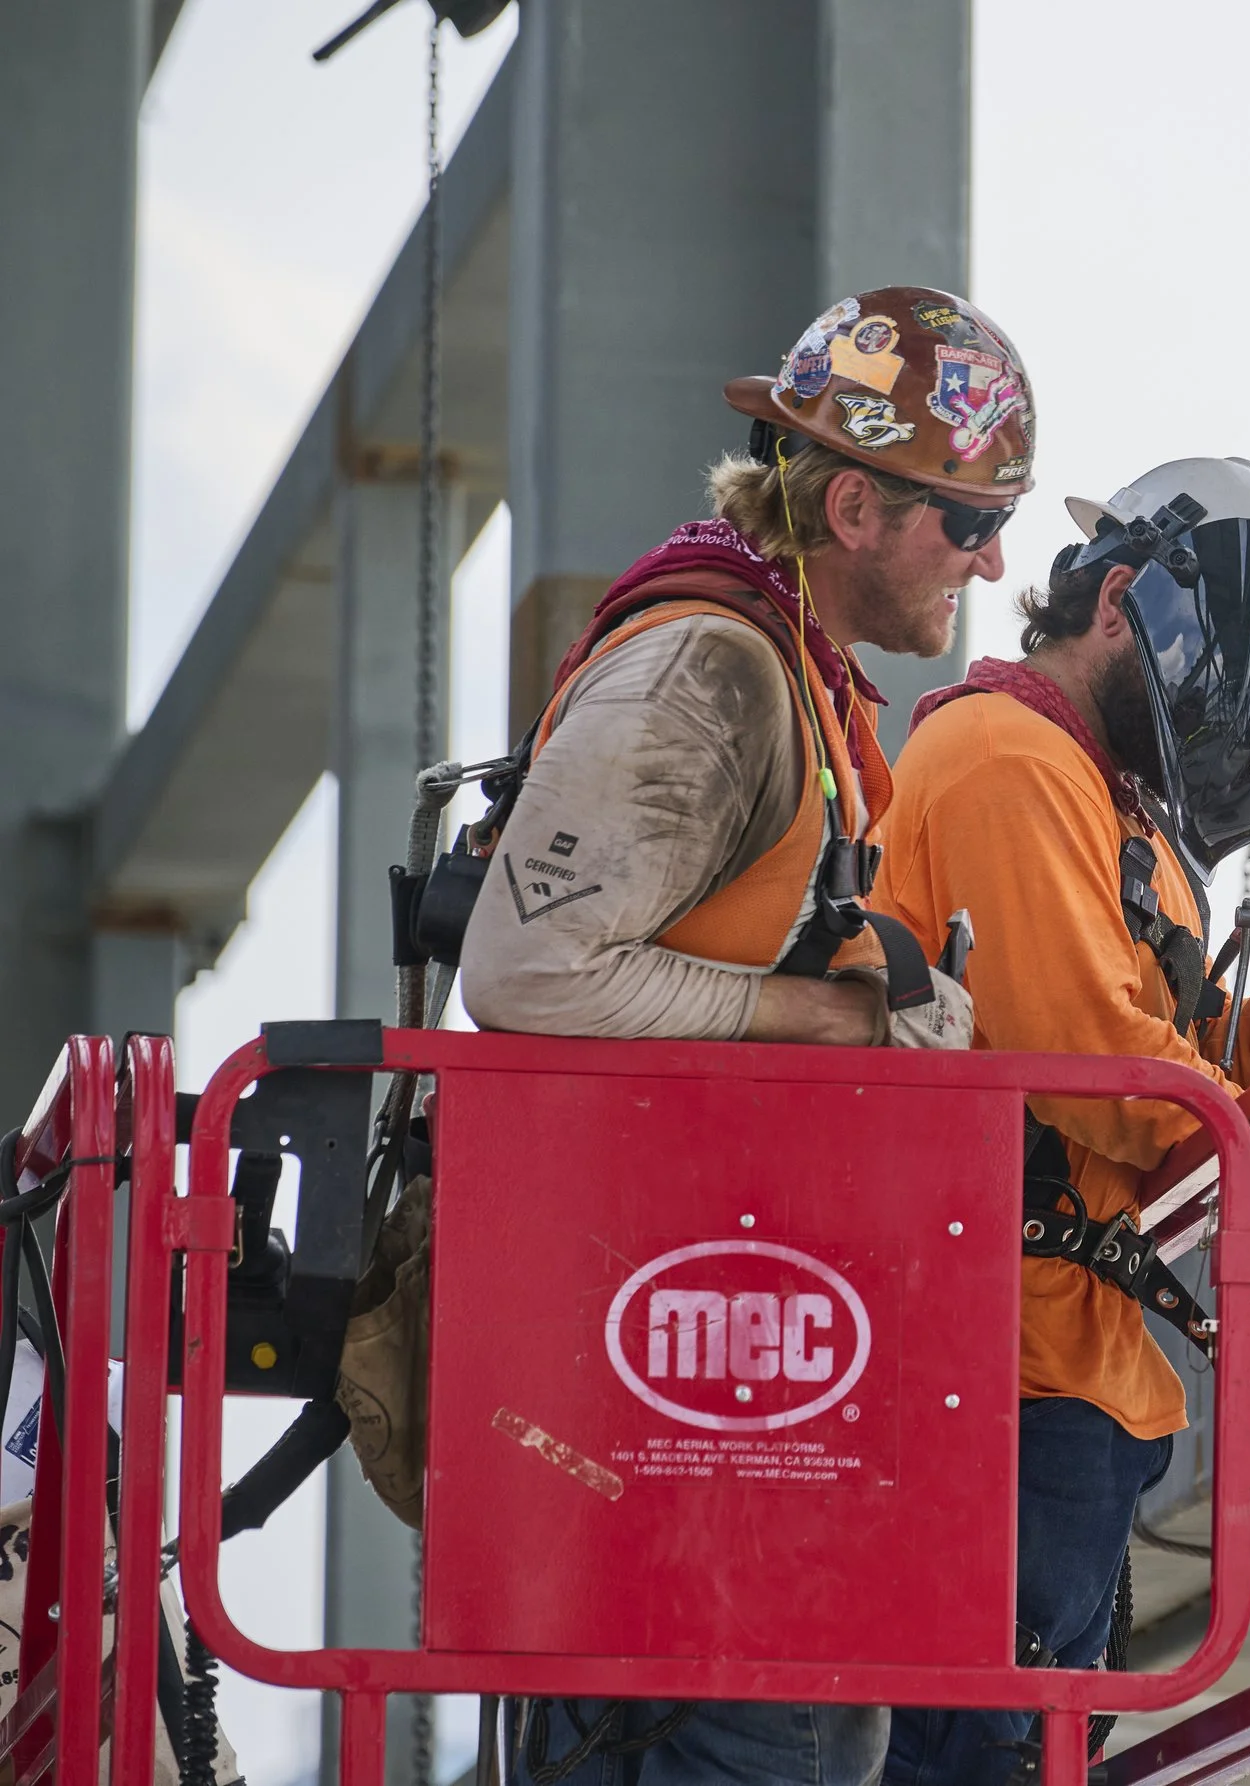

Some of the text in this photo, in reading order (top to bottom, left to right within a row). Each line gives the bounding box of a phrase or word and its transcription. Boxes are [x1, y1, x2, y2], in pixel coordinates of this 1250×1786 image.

[554, 838, 574, 850] GAF
[524, 857, 577, 882] CERTIFIED
[647, 1438, 825, 1454] MEC AERIAL WORK PLATFORMS
[650, 1452, 700, 1463] MADERA
[784, 1456, 800, 1465] CA
[837, 1457, 861, 1468] USA
[736, 1469, 838, 1481] www.MECawp.com
